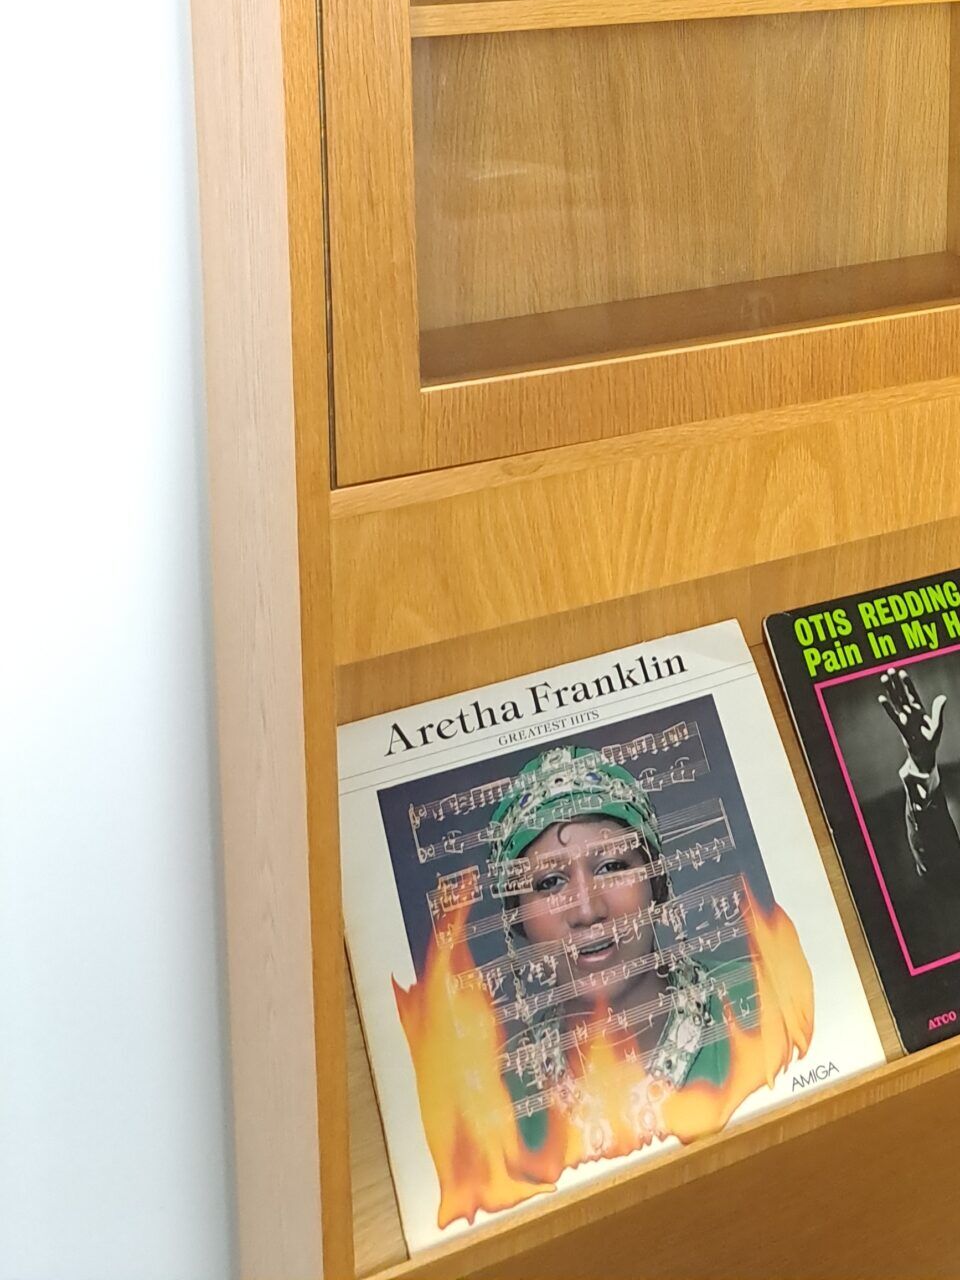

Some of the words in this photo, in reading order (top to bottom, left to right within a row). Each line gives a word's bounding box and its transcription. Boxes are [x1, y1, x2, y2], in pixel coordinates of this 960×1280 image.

[793, 608, 852, 646] OTIS
[803, 640, 863, 677] Pain
[867, 631, 897, 659] In
[901, 620, 940, 650] My
[384, 700, 525, 757] Aretha
[525, 652, 688, 716] Franklin
[498, 719, 568, 746] GREATEST
[570, 709, 600, 727] HITS
[928, 1011, 957, 1030] ATCO
[791, 1061, 840, 1092] AMIGA
